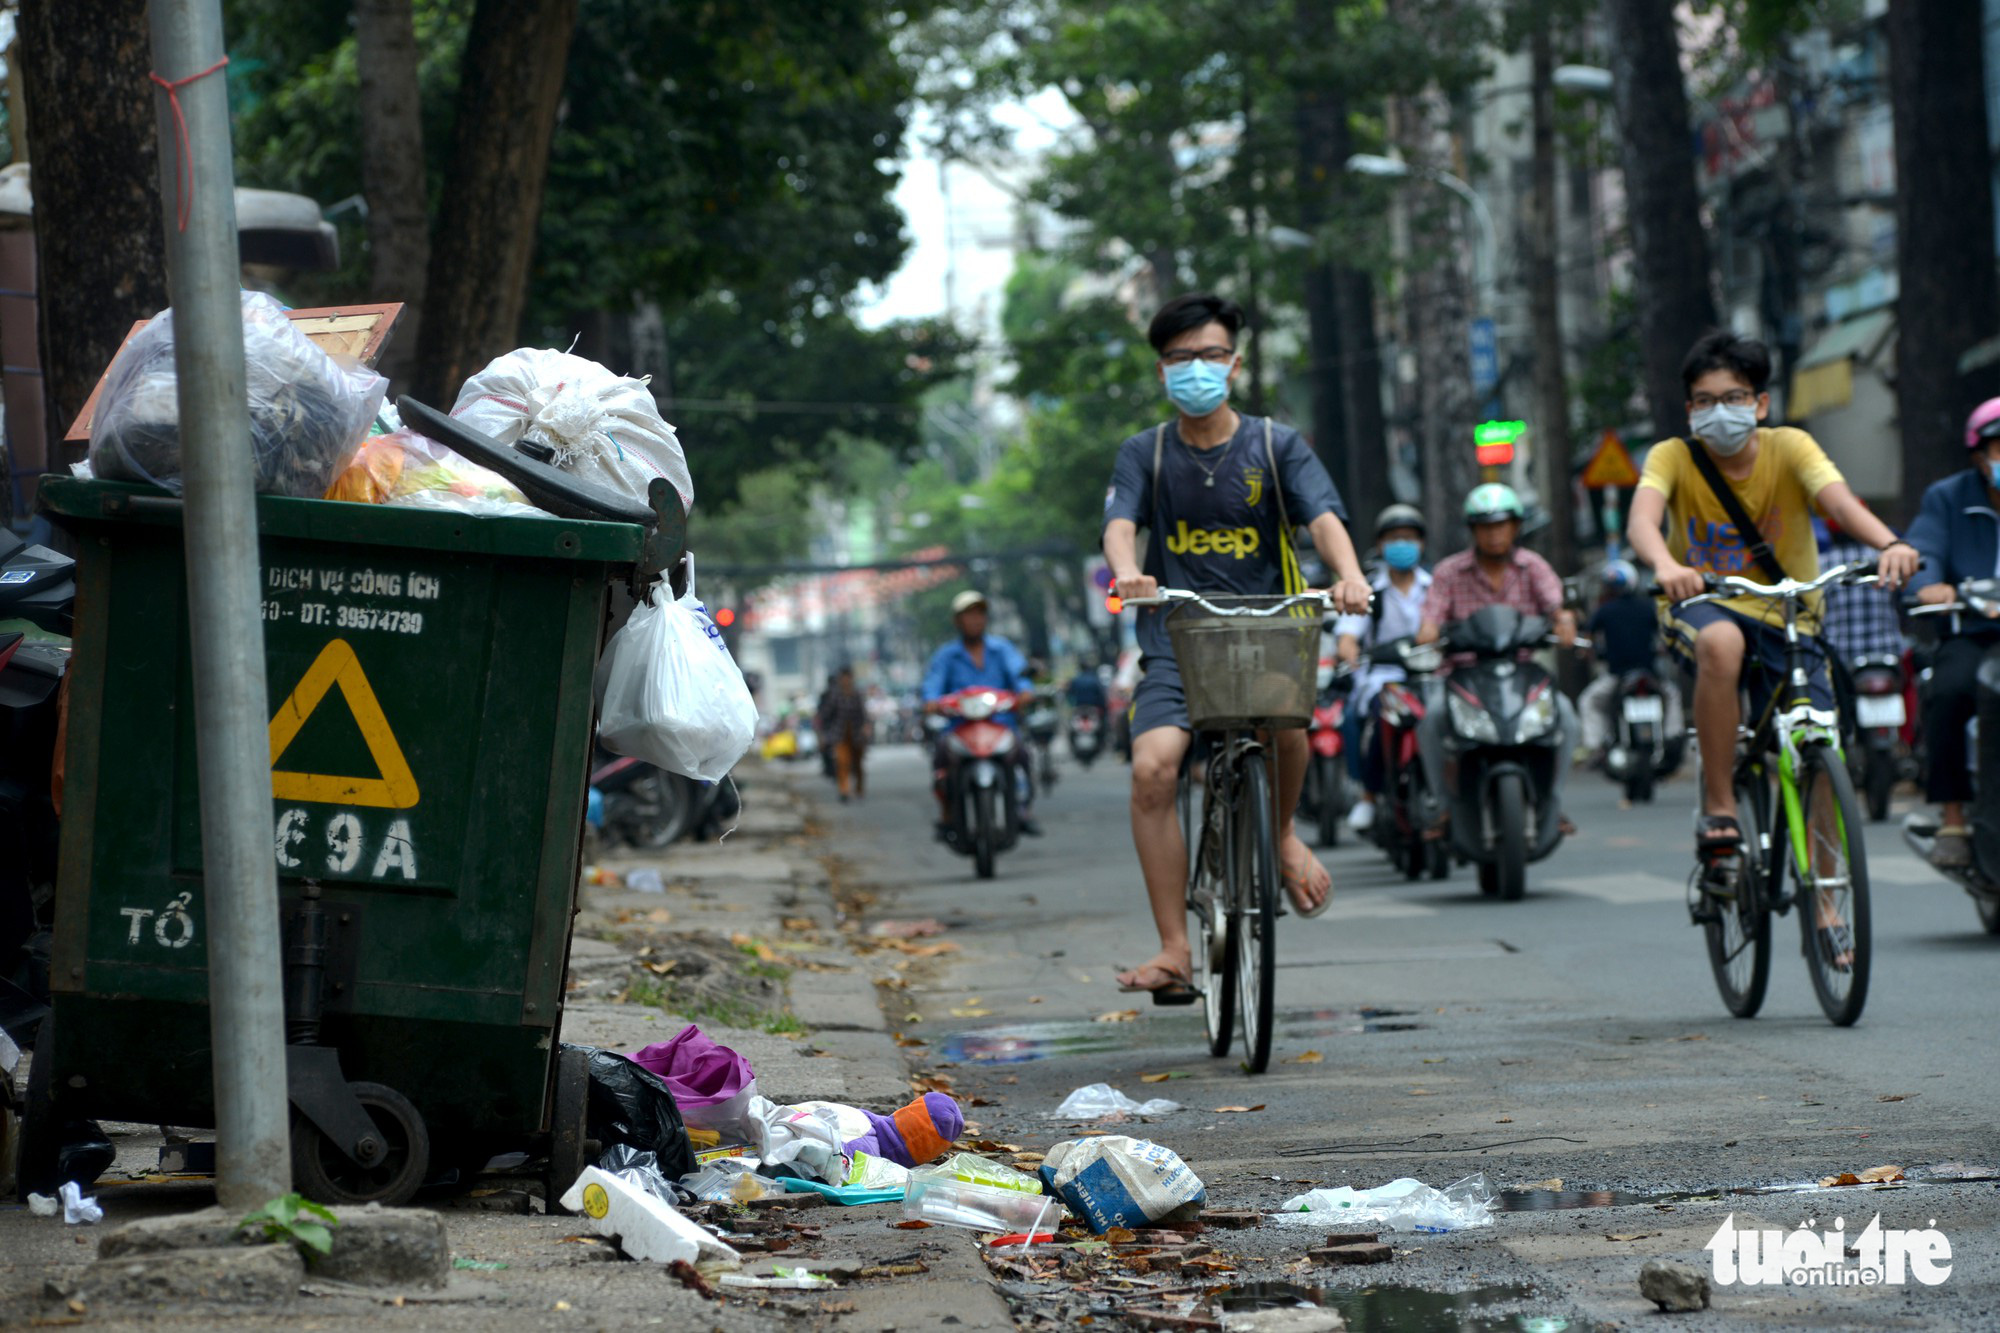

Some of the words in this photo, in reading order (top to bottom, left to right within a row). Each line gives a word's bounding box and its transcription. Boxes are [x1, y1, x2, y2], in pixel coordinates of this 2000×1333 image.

[1166, 520, 1260, 560] Jeep
[1687, 516, 1745, 551] US
[351, 568, 402, 597] CÔNG
[408, 572, 440, 599] ÍCH
[120, 891, 194, 948] TỔ
